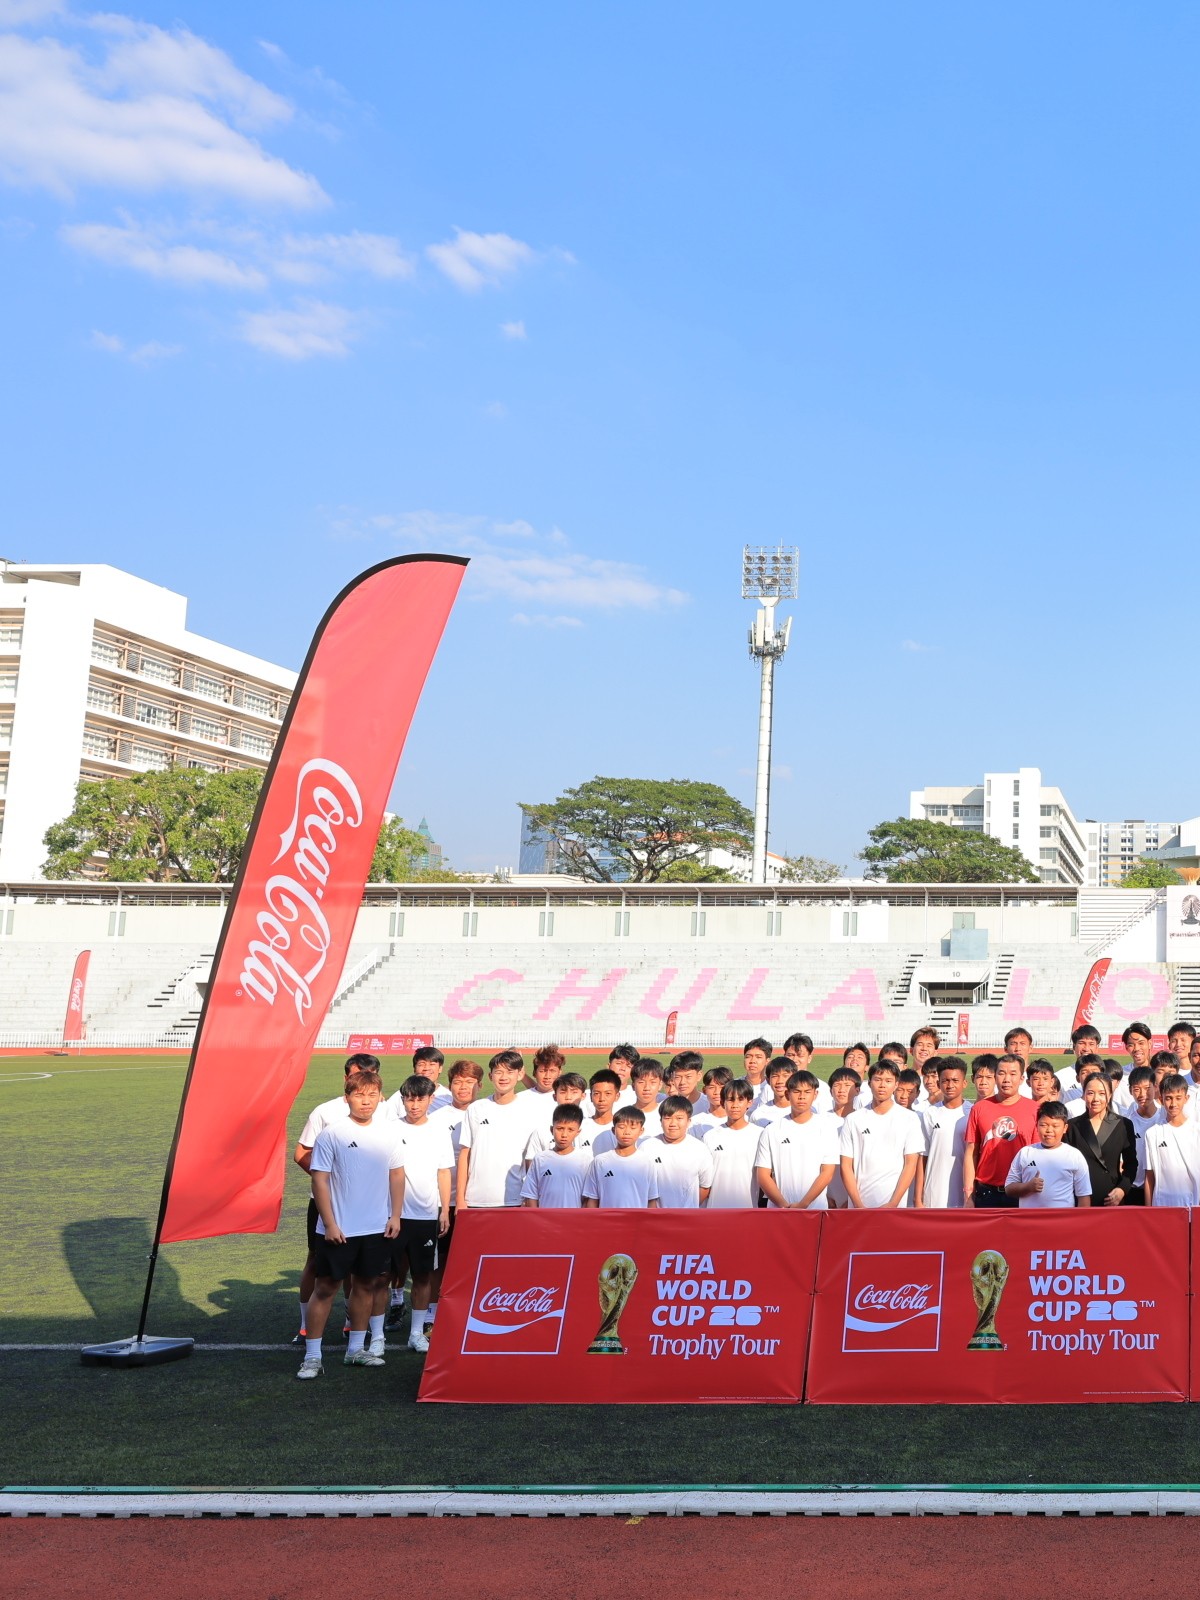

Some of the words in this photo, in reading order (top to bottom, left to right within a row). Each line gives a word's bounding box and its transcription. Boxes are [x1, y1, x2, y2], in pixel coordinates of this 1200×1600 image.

[239, 758, 363, 1027] Coca-Cola
[659, 1254, 715, 1275] FIFA
[1030, 1250, 1086, 1270] FIFA
[656, 1279, 752, 1301] WORLD
[854, 1283, 933, 1310] Coca-Cola
[1028, 1275, 1126, 1296] WORLD
[479, 1286, 560, 1313] Coca-Cola
[651, 1305, 706, 1327] CUP
[1027, 1301, 1082, 1322] CUP
[649, 1334, 728, 1360] Trophy
[729, 1334, 781, 1356] Tour
[1027, 1329, 1106, 1356] Trophy
[1109, 1329, 1160, 1351] Tour
